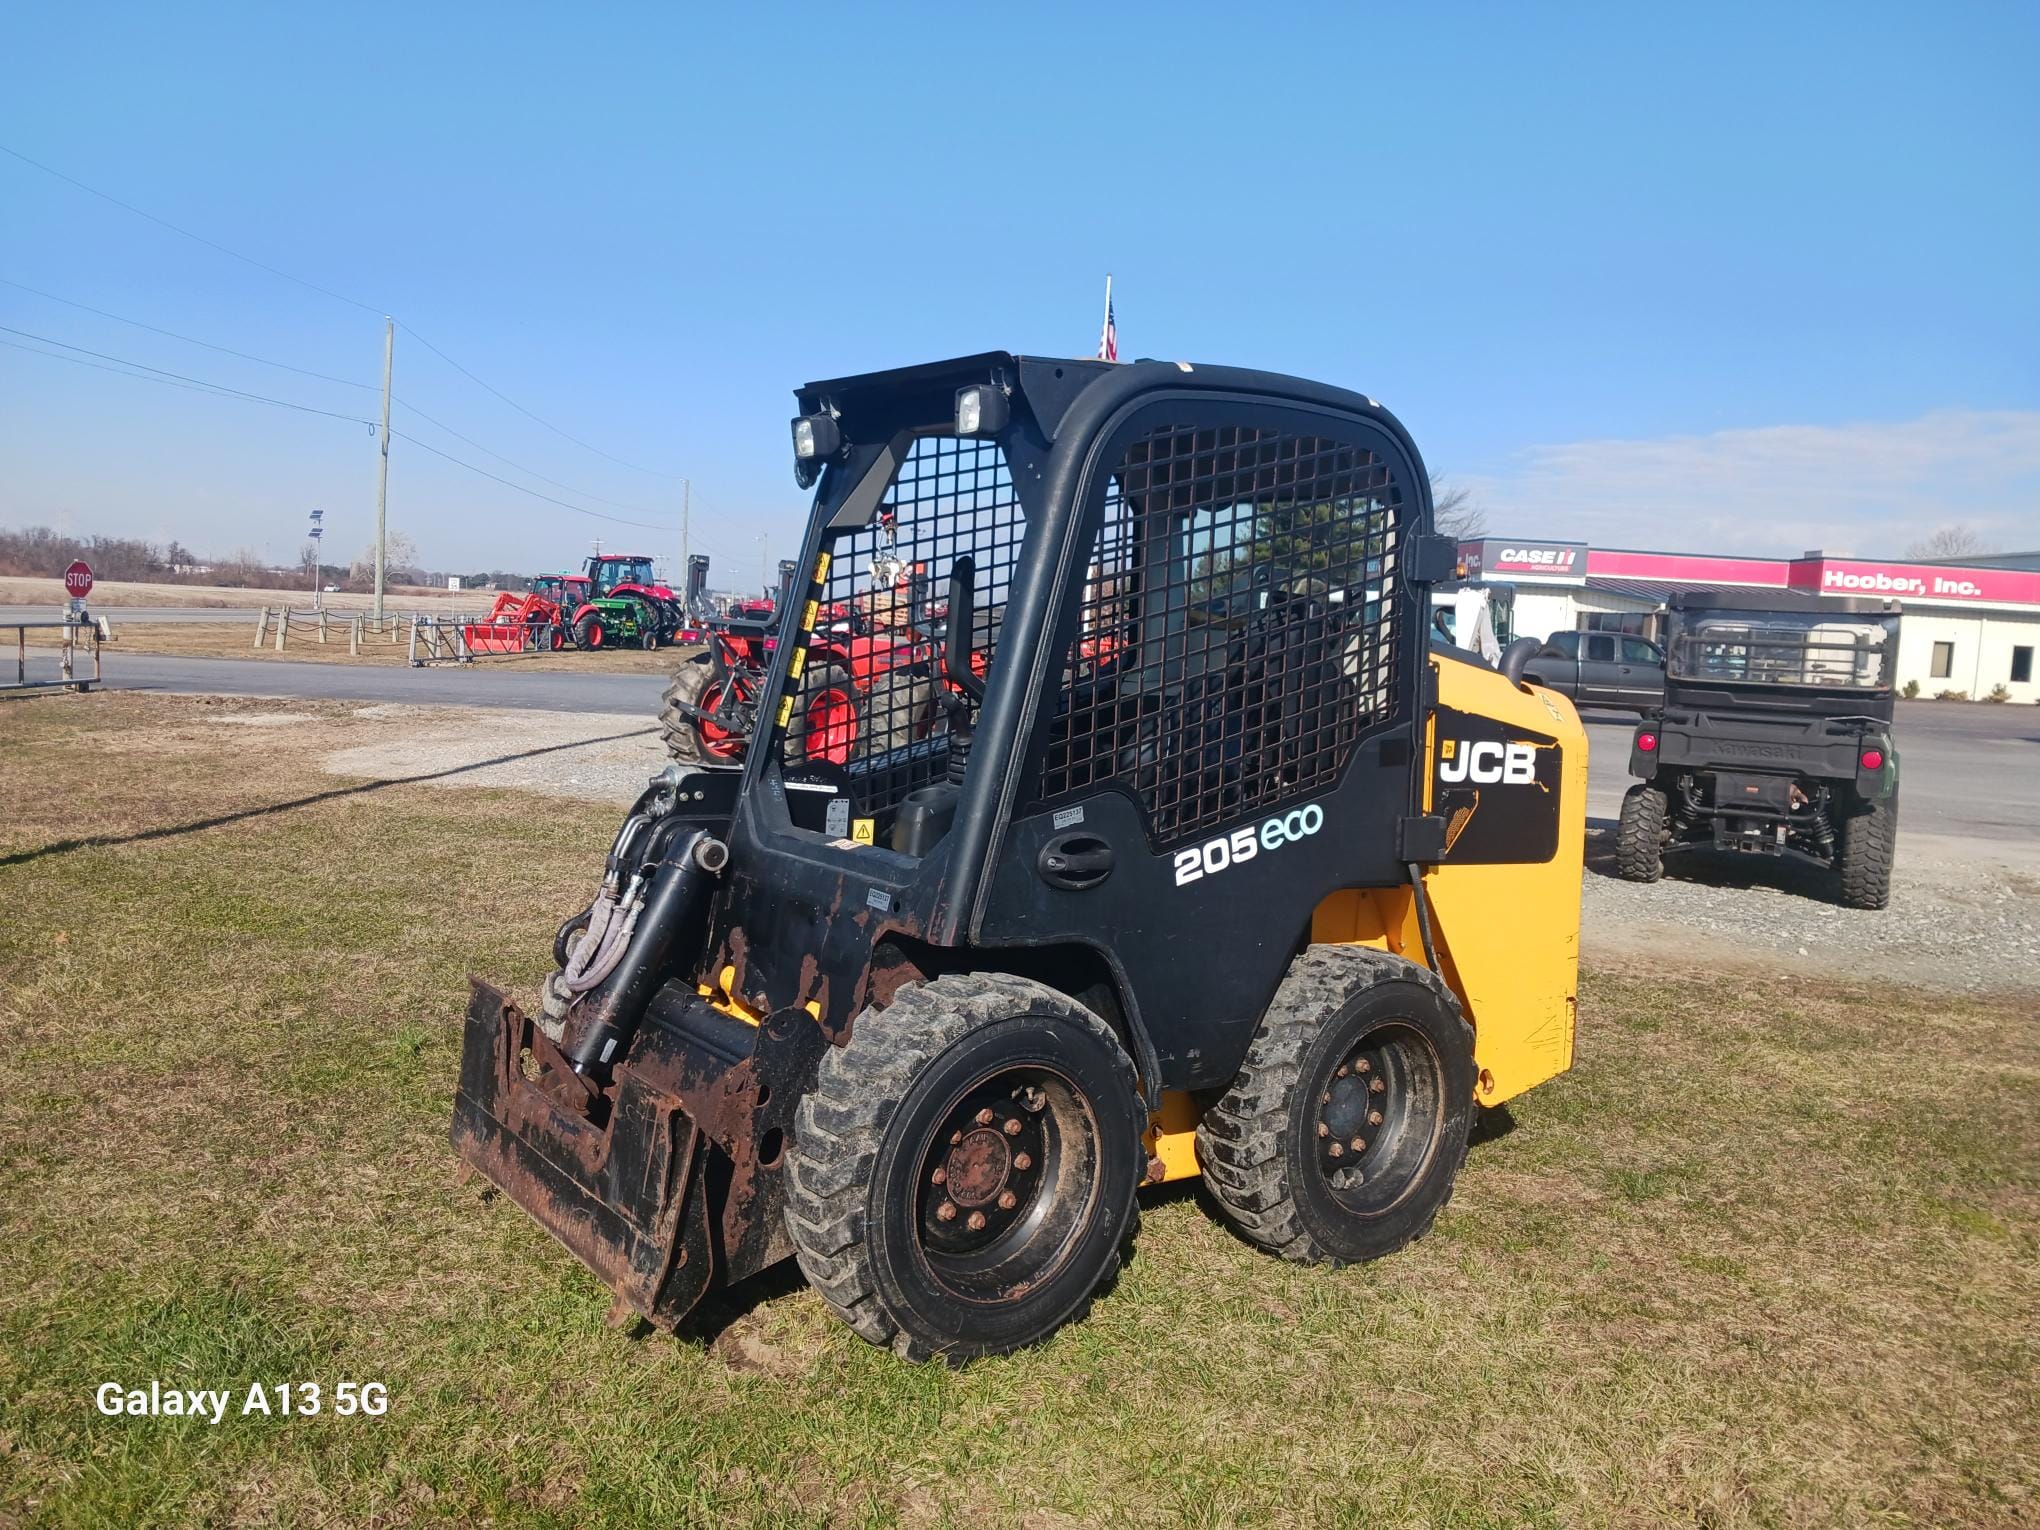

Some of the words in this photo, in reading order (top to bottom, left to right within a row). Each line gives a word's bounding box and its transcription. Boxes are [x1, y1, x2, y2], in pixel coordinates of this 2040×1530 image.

[1500, 548, 1555, 564] CASE
[67, 572, 92, 587] STOP
[1824, 570, 1926, 595] Hoober,
[1934, 576, 1982, 596] Inc.
[1440, 740, 1536, 784] JCB
